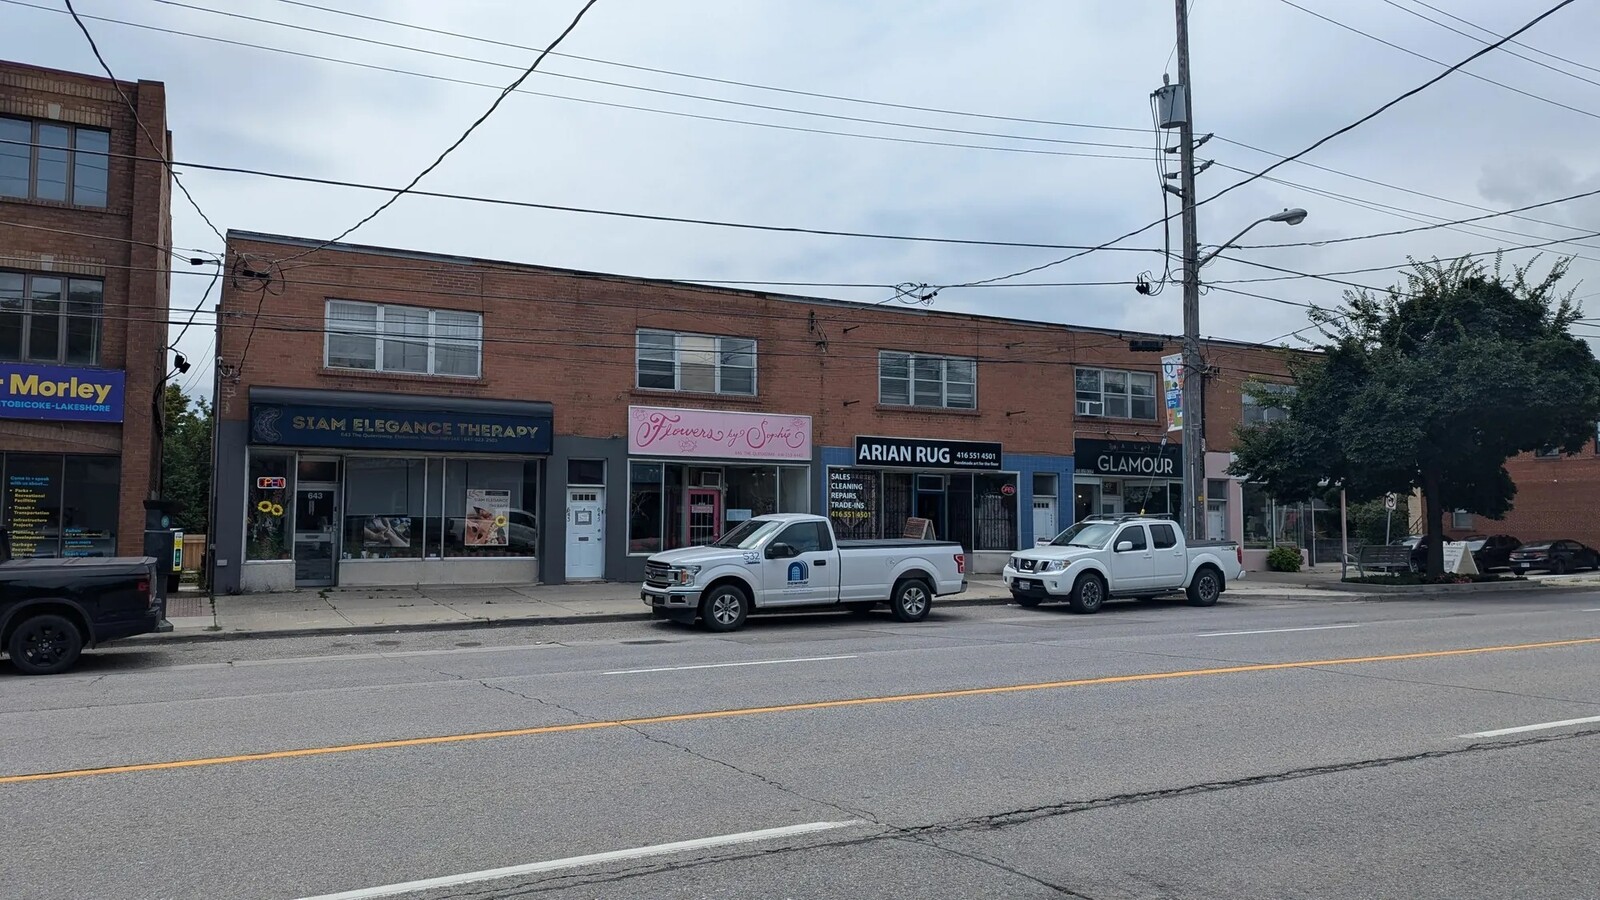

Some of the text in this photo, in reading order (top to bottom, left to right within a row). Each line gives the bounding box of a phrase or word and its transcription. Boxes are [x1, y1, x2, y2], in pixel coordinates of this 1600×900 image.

[10, 373, 112, 404] Morley
[0, 400, 110, 412] TOBICOKE-LAKESHORE
[292, 416, 539, 439] SIAM ELEGANCE THERAPY
[636, 412, 805, 449] Flowers by Sophie
[858, 444, 950, 464] ARIAN RUG
[956, 451, 996, 460] 416 551 4501
[1097, 454, 1173, 474] GLAMOUR
[831, 482, 863, 490] CLEANING
[831, 501, 865, 509] TRADE-INS
[831, 510, 843, 518] 416
[742, 552, 760, 560] S32
